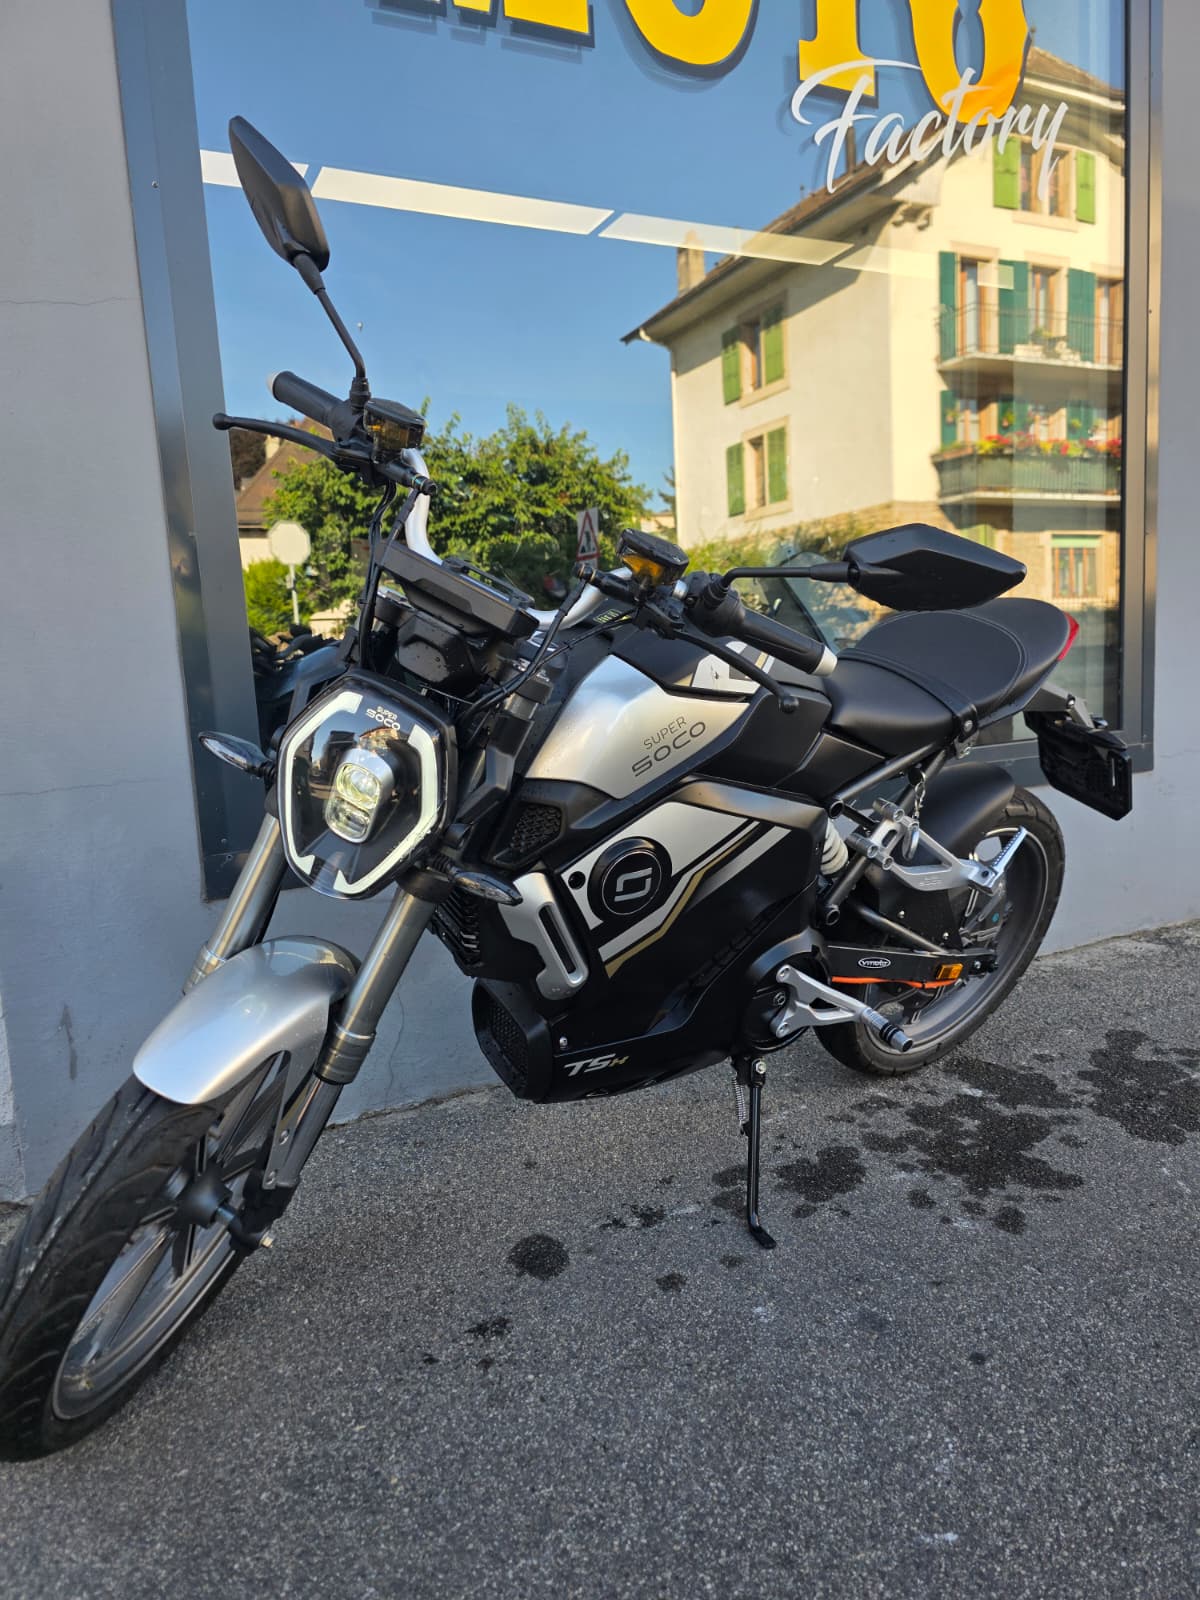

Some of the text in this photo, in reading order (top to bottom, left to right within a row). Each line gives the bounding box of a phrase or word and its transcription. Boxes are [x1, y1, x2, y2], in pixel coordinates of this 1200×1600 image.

[791, 59, 1069, 201] Factory
[365, 708, 401, 730] SOCO
[643, 716, 687, 750] SUPER
[631, 721, 706, 777] SOCO
